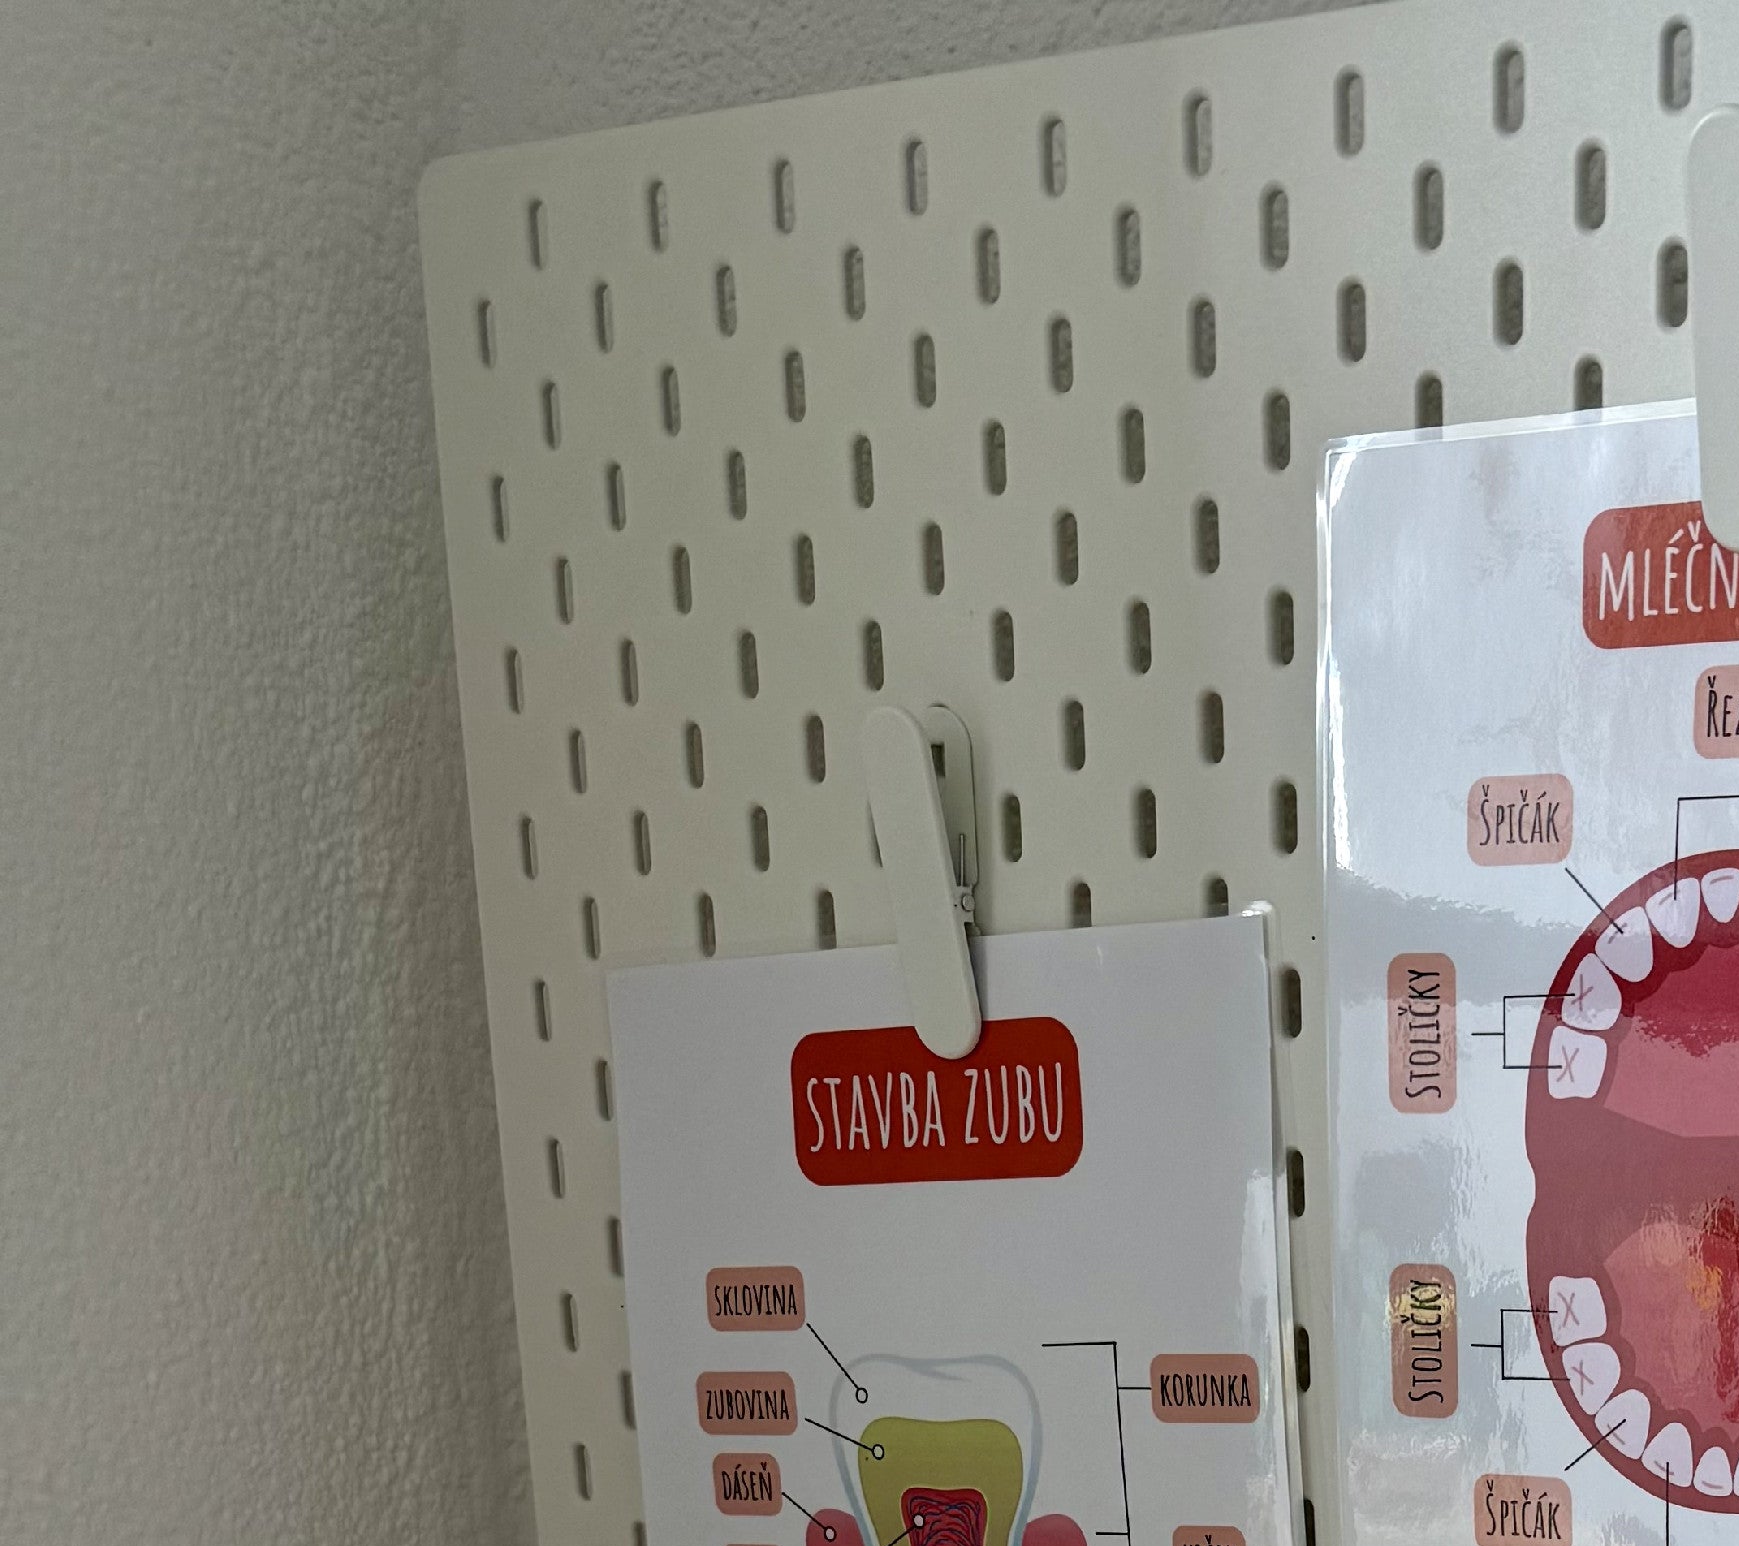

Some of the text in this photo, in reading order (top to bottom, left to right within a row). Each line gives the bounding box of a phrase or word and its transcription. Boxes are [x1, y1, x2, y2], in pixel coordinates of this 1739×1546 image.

[1477, 784, 1561, 847] ŠPIČÁK
[1404, 967, 1443, 1100] STOLIČKY
[806, 1061, 1065, 1153] STAVBA ZUBU
[714, 1283, 798, 1317] SKLOVINA
[1406, 1278, 1443, 1404] STOLIČKY
[705, 1387, 791, 1421] ZUBOVINA
[1159, 1372, 1252, 1408] KORUNKA
[720, 1461, 775, 1503] DÁSEŇ
[1484, 1479, 1563, 1540] ŠPIČÁK
